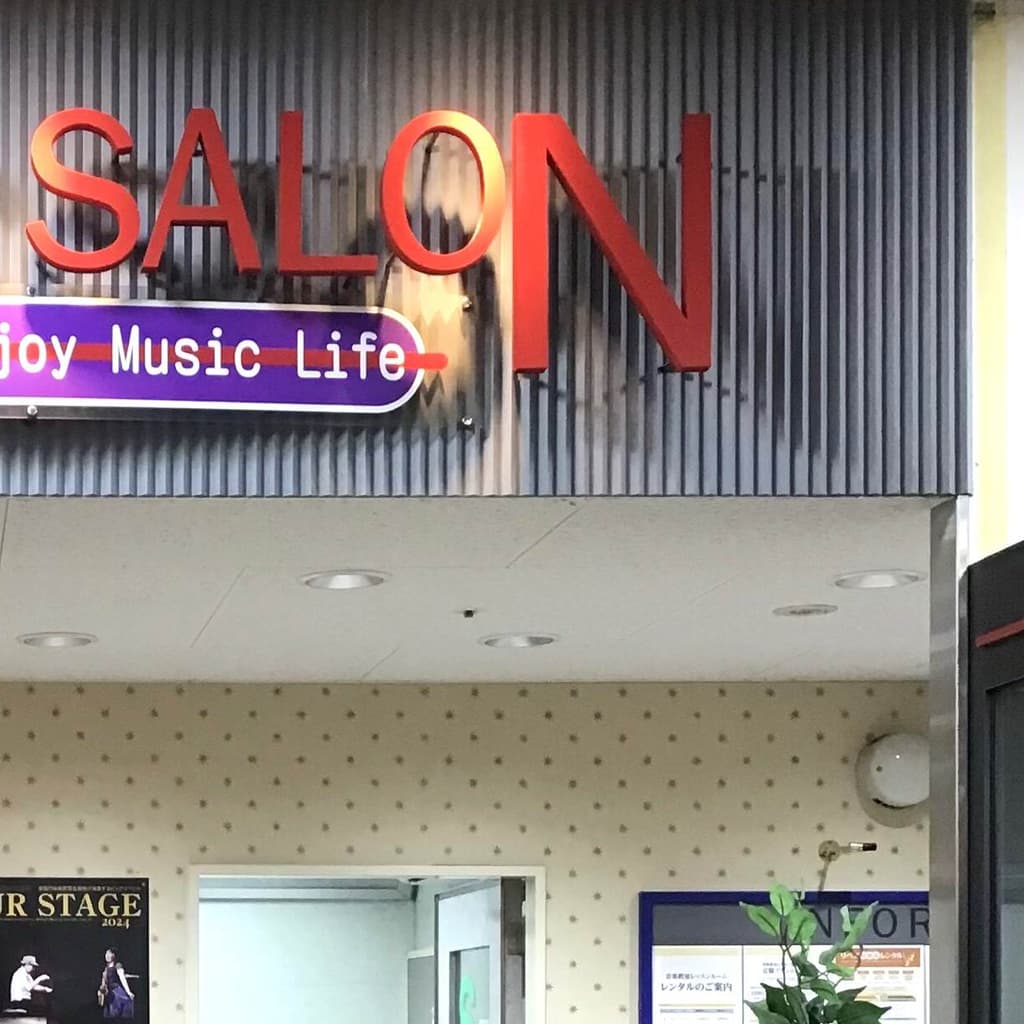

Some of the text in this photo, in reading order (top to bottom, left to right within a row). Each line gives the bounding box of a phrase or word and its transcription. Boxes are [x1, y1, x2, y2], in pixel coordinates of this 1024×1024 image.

[26, 108, 711, 373] SALON
[111, 325, 261, 377] Music
[296, 328, 406, 382] Life
[37, 892, 143, 917] STAGE
[101, 917, 130, 929] 2024
[660, 982, 733, 992] レンタルのご案内
